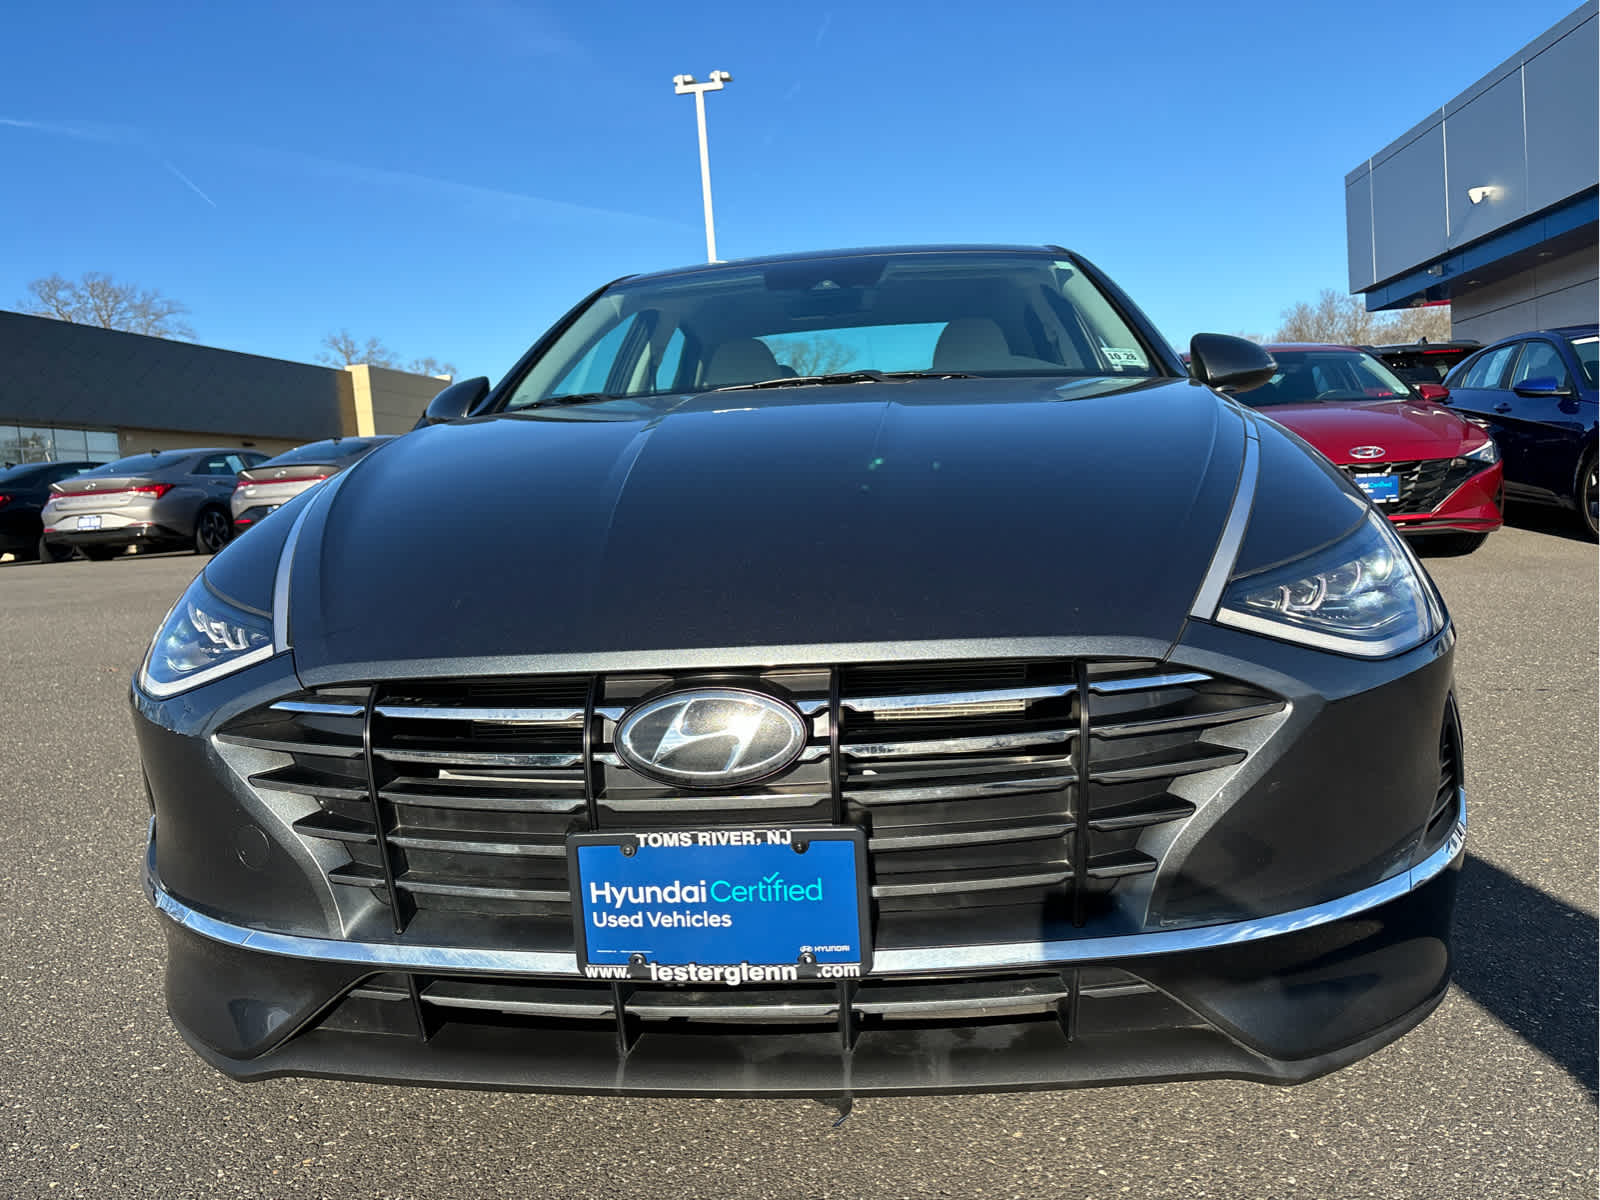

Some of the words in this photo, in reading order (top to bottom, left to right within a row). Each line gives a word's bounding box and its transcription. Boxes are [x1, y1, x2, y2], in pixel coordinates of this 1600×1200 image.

[635, 832, 693, 849] TOMS
[697, 830, 762, 847] RIVER,
[766, 829, 793, 845] NJ
[589, 880, 707, 909] Hyundai
[710, 872, 823, 903] Certified
[592, 911, 644, 928] Used
[647, 910, 733, 928] Vehicles
[814, 944, 850, 953] HYUNDAI
[584, 966, 632, 980] www.
[650, 962, 798, 986] lesterglenn
